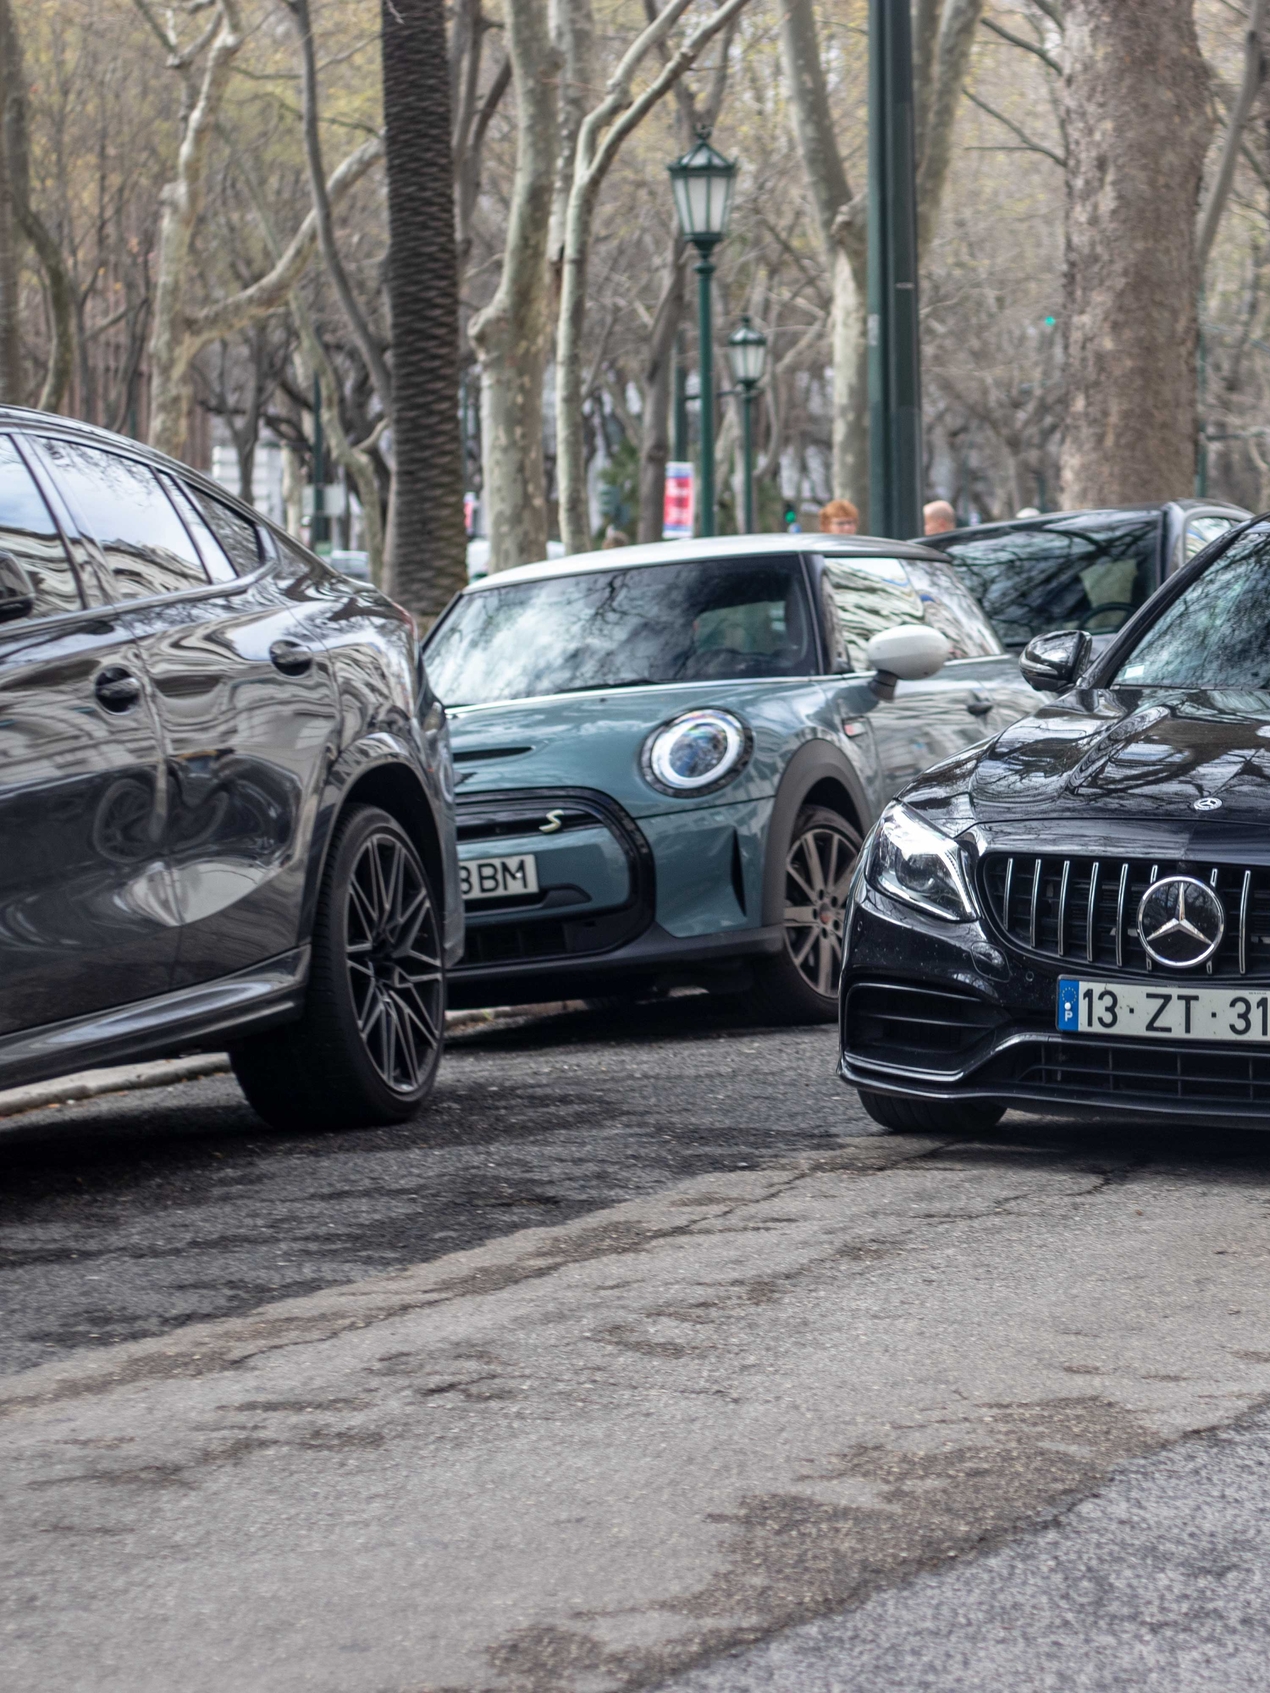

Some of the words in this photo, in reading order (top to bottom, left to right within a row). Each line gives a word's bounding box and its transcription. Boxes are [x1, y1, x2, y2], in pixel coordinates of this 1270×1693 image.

[539, 809, 564, 833] S
[1064, 1010, 1073, 1022] P
[1083, 988, 1118, 1028] 13
[1146, 992, 1200, 1034] ZT
[1229, 996, 1268, 1036] 31
